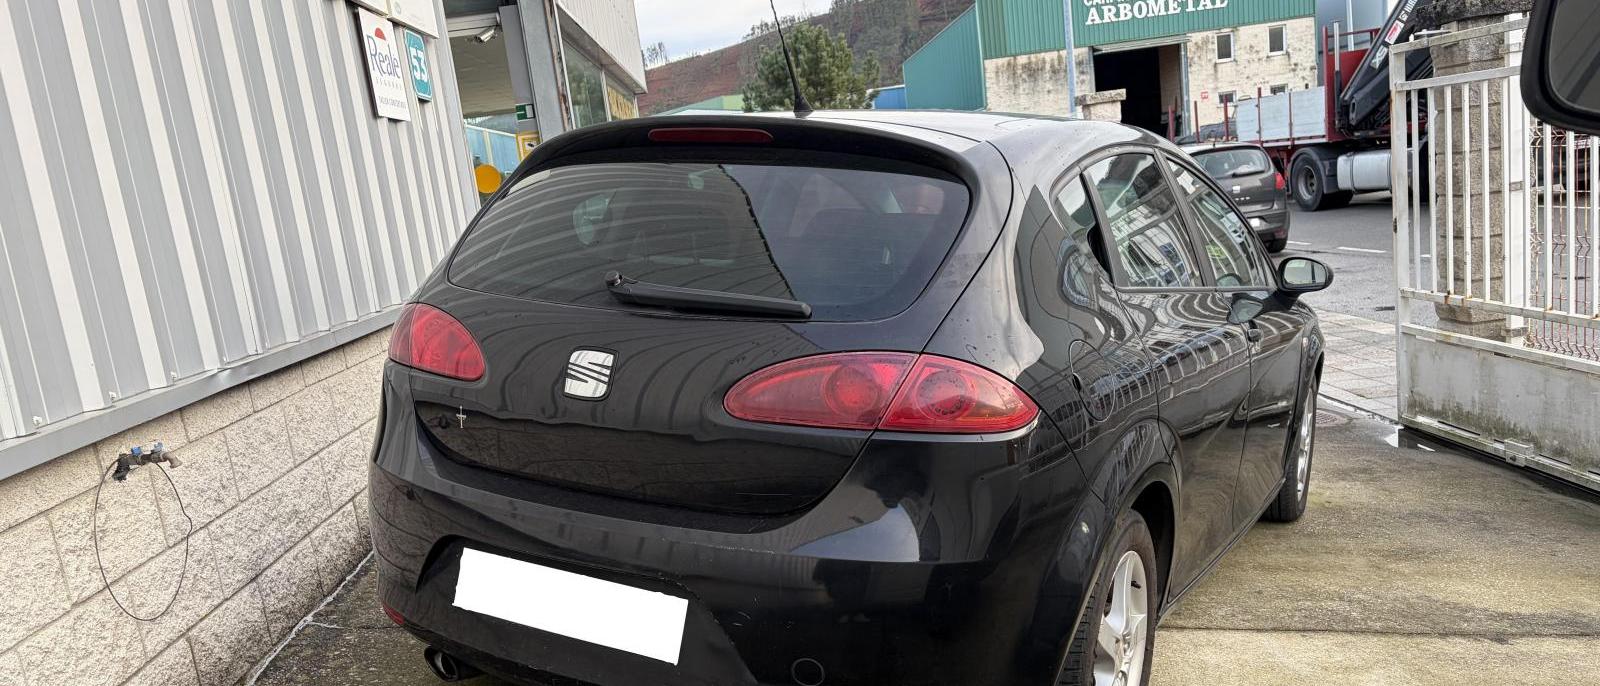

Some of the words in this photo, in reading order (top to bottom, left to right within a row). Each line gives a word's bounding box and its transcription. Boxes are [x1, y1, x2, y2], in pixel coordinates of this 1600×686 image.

[1085, 0, 1229, 25] ARBOMETAL
[366, 34, 401, 79] Reale
[410, 46, 428, 82] 53
